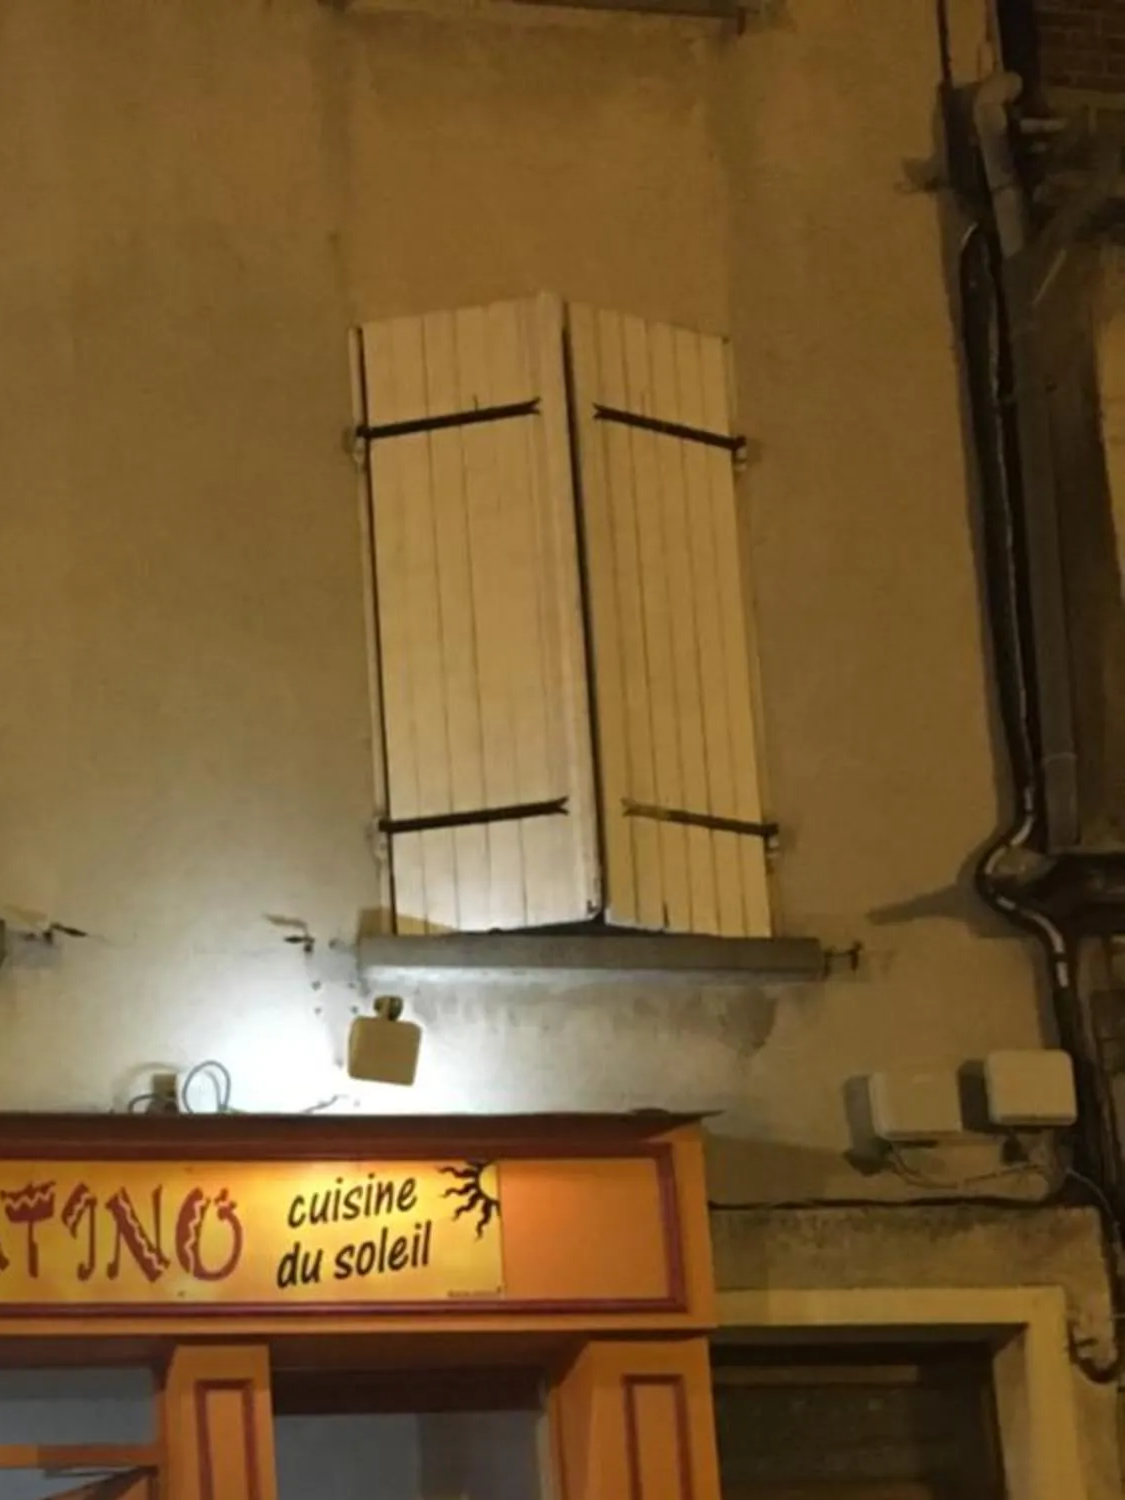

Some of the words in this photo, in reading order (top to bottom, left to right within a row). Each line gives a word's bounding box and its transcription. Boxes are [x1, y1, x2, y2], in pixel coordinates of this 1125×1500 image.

[287, 1172, 418, 1229] cuisine
[277, 1241, 324, 1289] du
[333, 1220, 432, 1280] soleil
